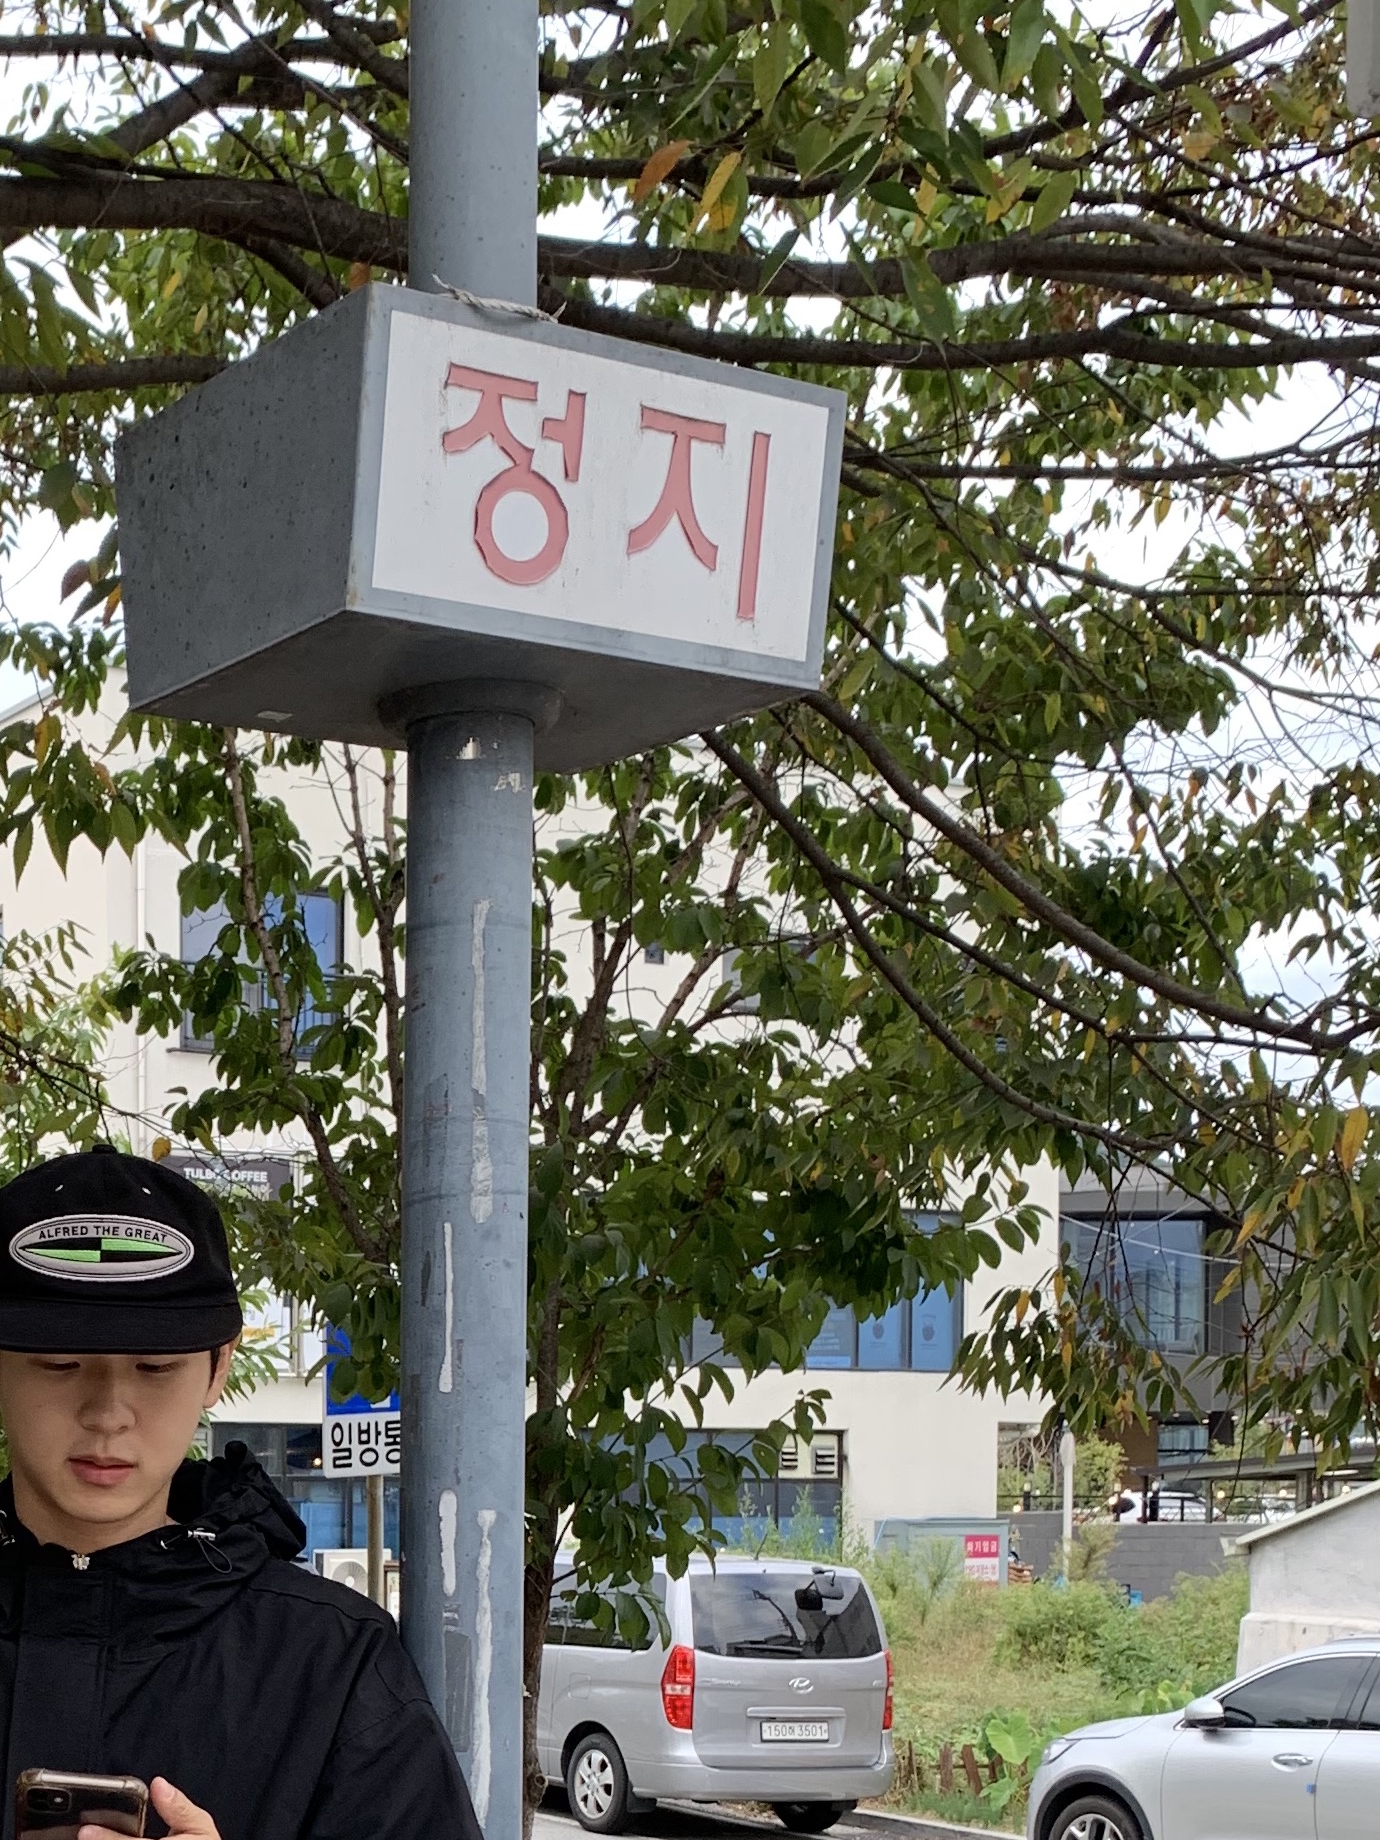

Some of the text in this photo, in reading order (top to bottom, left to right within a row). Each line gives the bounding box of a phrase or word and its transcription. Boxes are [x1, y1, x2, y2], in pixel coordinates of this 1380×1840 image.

[442, 361, 771, 621] 정지
[38, 1224, 167, 1244] ALFRED THE GREAT
